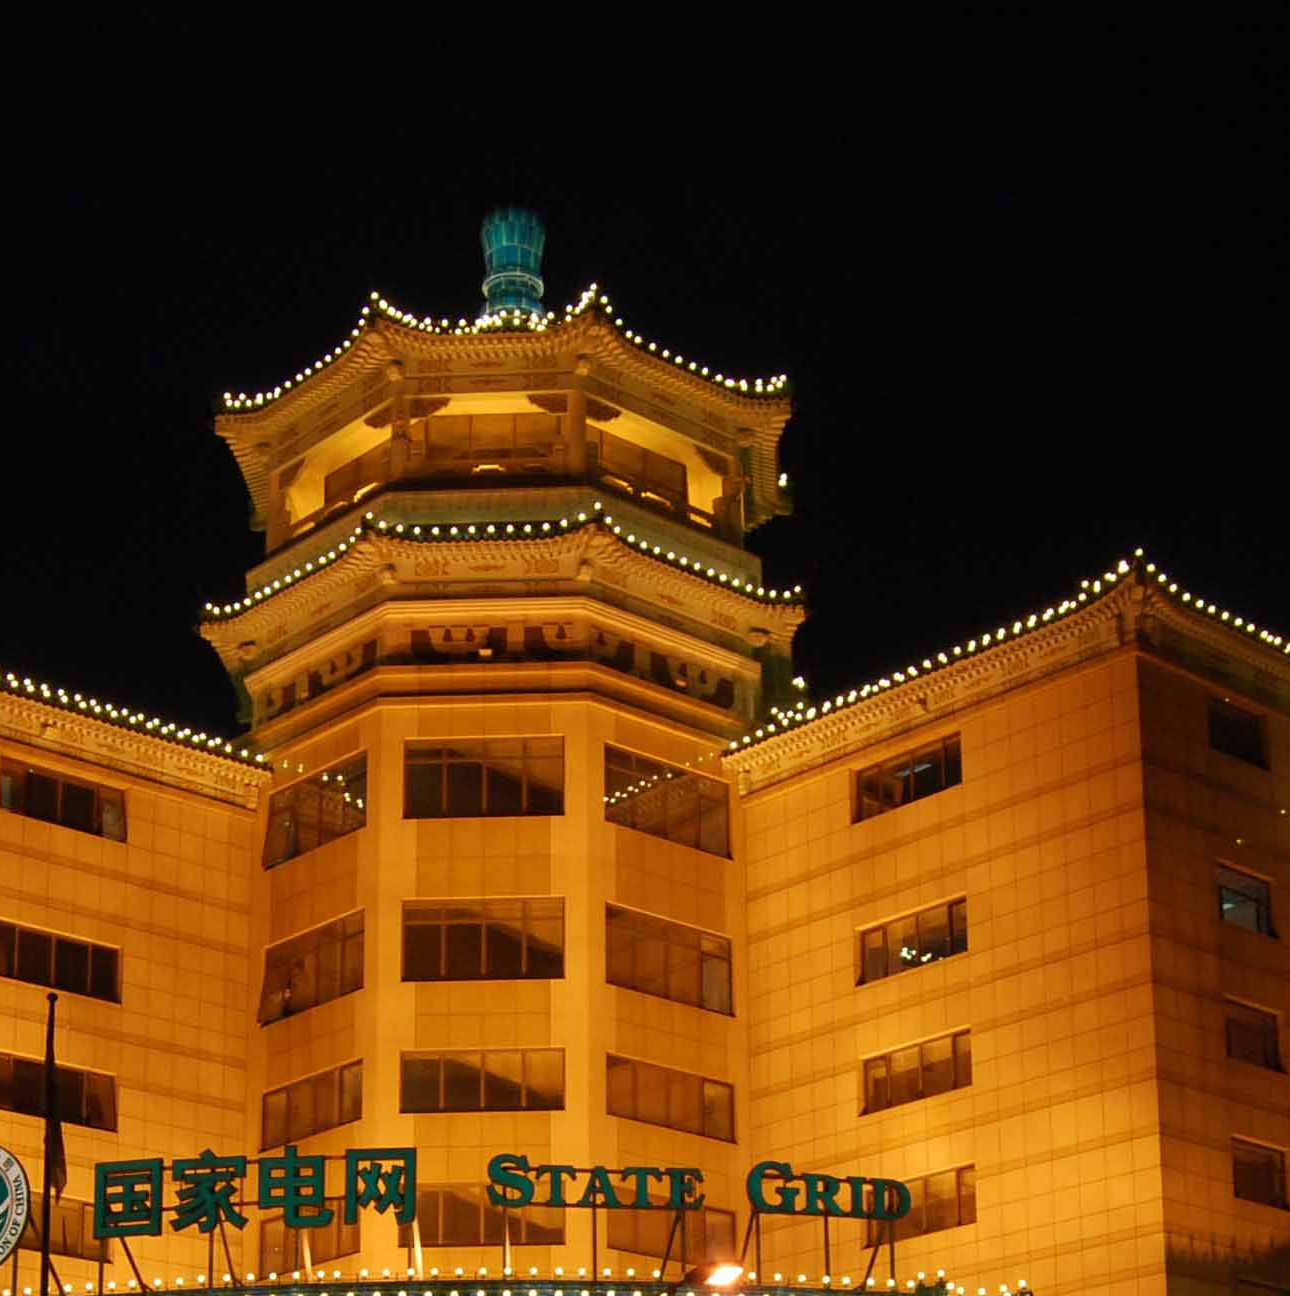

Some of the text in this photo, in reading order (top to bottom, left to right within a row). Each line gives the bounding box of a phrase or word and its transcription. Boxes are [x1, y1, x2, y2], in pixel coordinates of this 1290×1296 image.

[12, 1173, 25, 1217] CHINA
[93, 1145, 417, 1240] 国家电网
[486, 1154, 911, 1220] STATE GRID
[9, 1217, 22, 1236] OF
